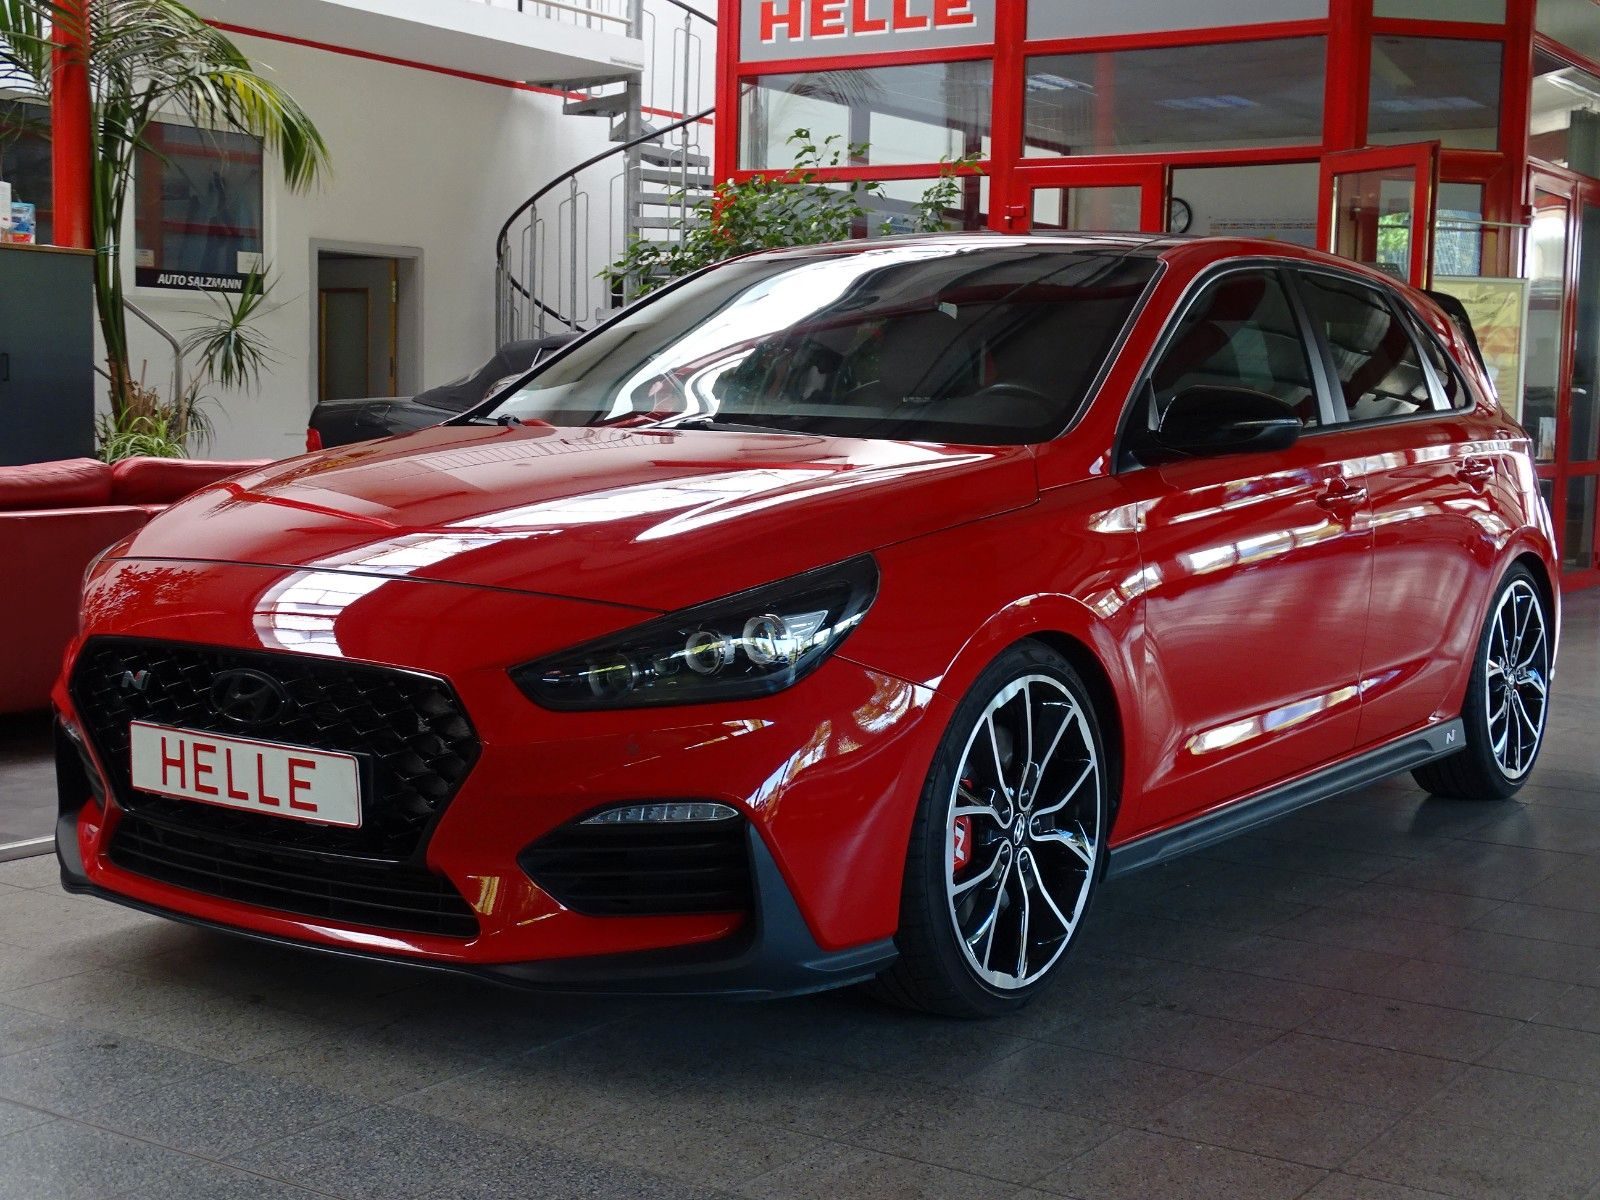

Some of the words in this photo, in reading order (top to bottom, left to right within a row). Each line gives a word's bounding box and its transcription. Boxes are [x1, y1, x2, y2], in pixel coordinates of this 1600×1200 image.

[760, 0, 977, 44] HELLE
[157, 273, 186, 286] AUTO
[187, 275, 242, 289] SALZMANN
[161, 736, 318, 813] HELLE
